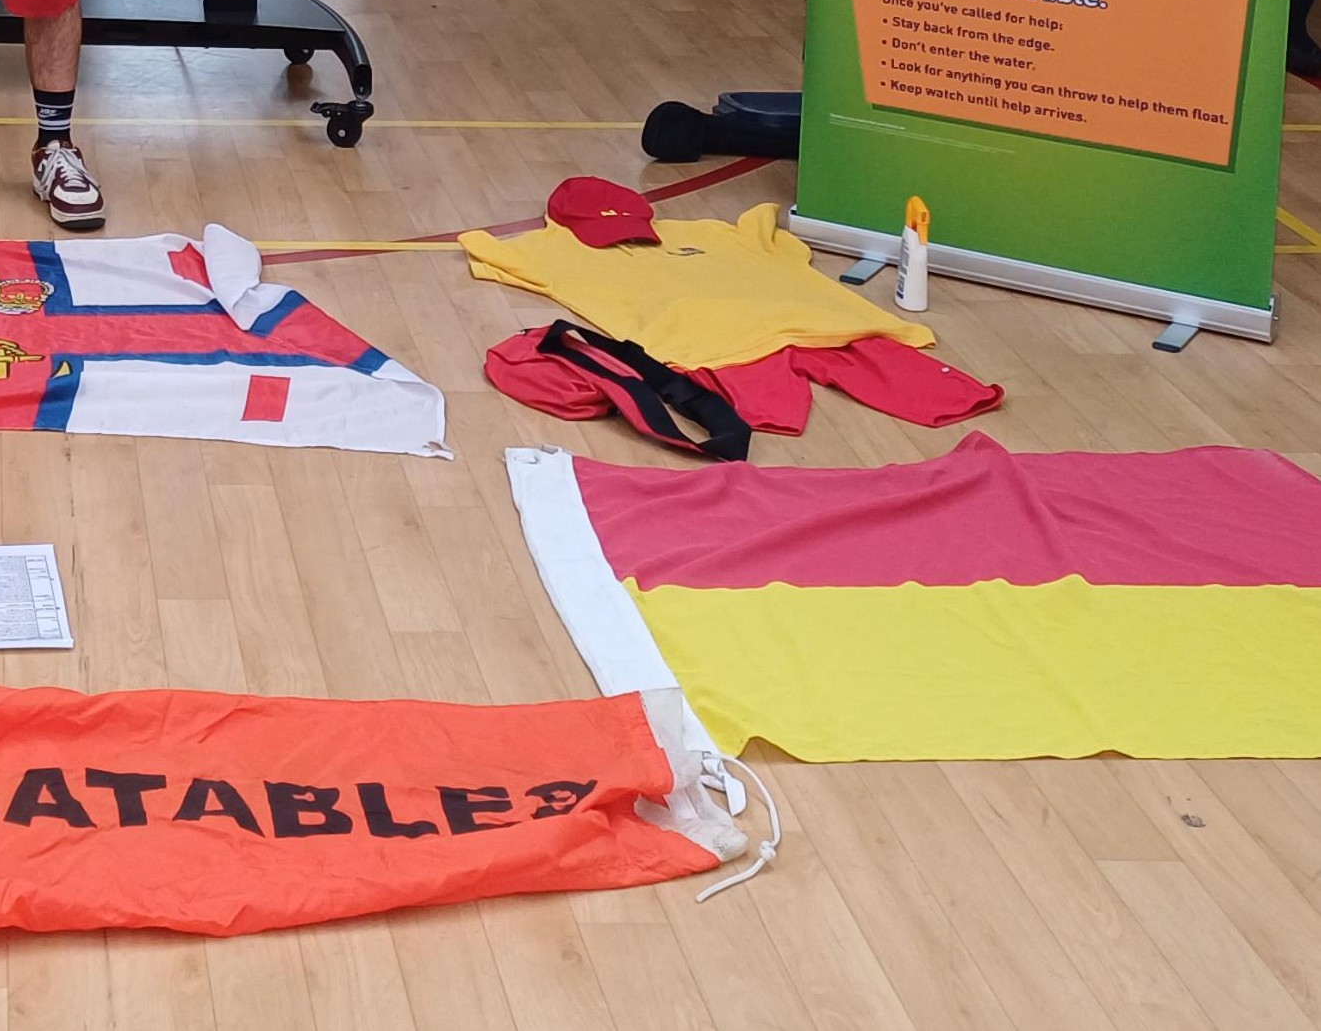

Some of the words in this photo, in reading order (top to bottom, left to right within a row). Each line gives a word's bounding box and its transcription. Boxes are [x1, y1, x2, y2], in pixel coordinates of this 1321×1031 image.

[892, 16, 920, 32] Stay
[923, 20, 953, 35] back
[956, 25, 988, 40] from
[992, 32, 1014, 45] the
[1017, 37, 1054, 51] edge.
[891, 37, 925, 53] Don't
[929, 45, 965, 58] enter
[968, 50, 990, 63] the
[993, 55, 1035, 70] water.
